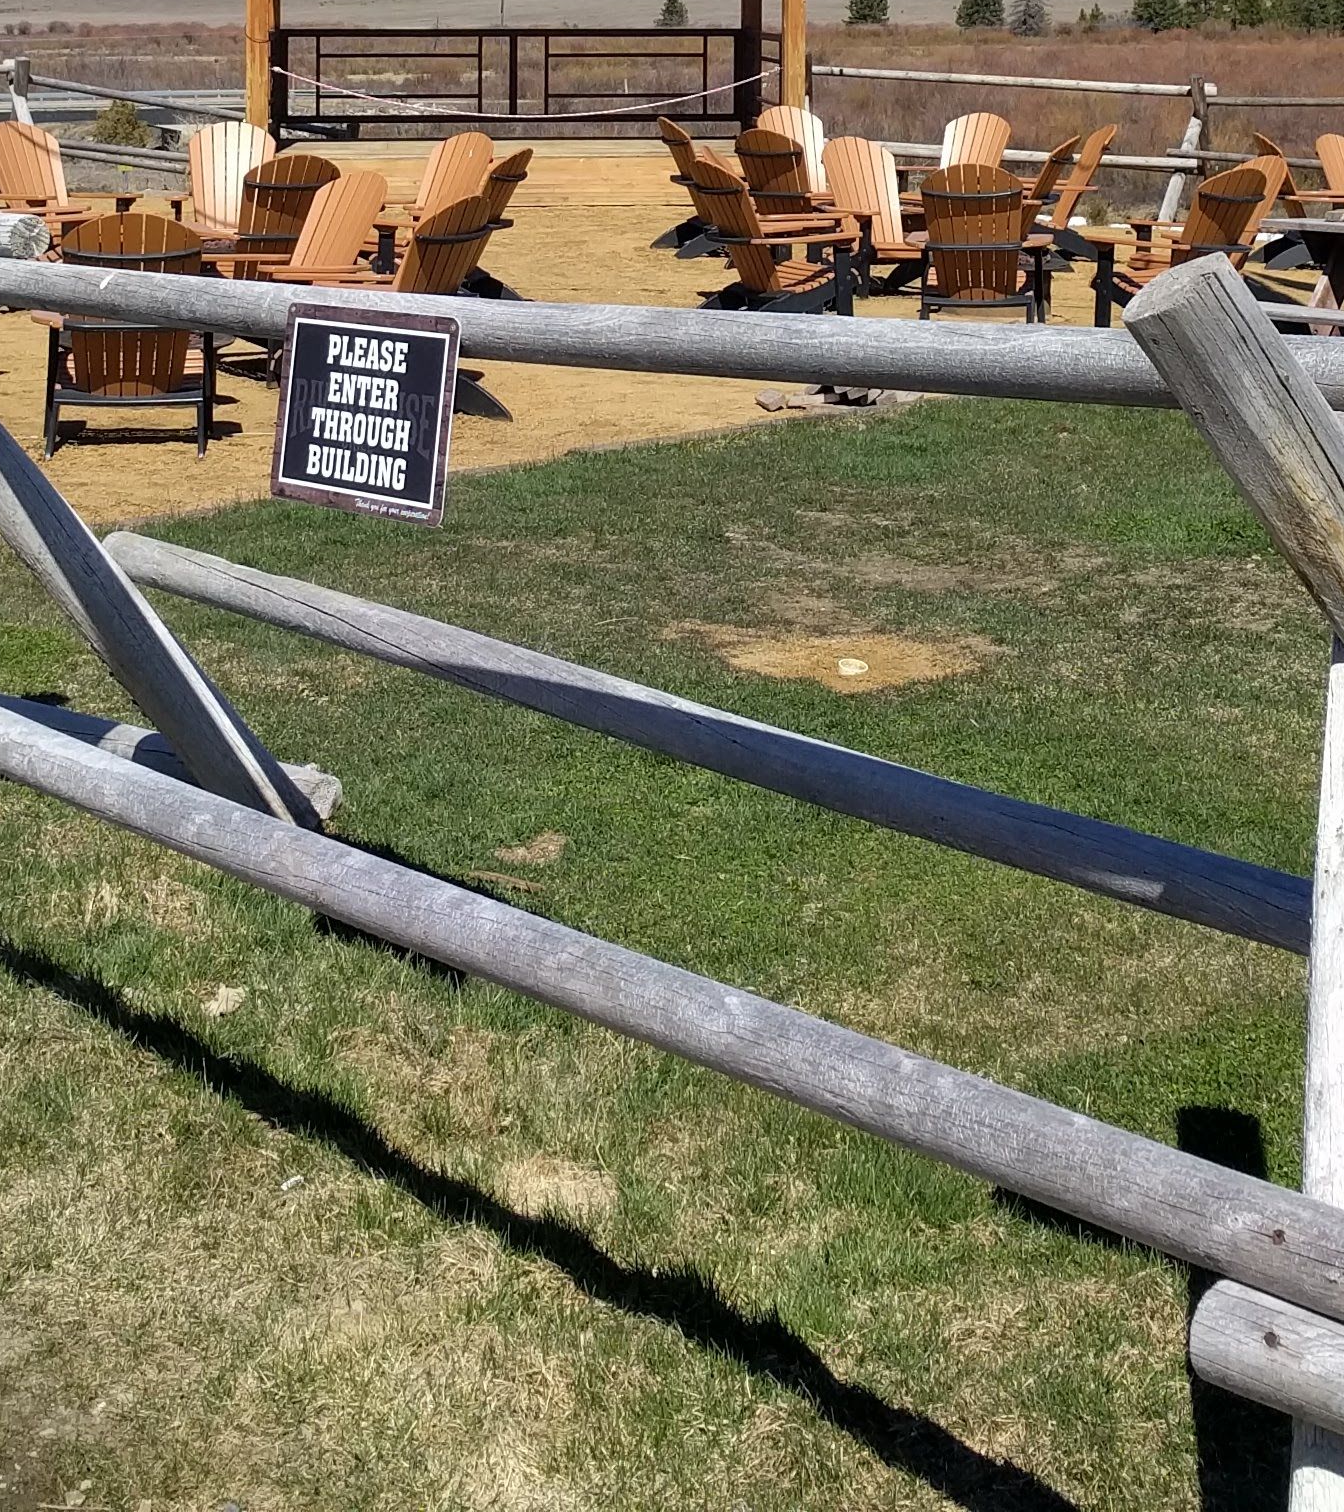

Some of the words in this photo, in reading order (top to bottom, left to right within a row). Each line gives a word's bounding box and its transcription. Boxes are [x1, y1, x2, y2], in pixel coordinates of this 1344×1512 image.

[326, 334, 409, 374] PLEASE
[327, 371, 400, 411] ENTER
[311, 406, 411, 452] THROUGH
[306, 443, 407, 491] BUILDING
